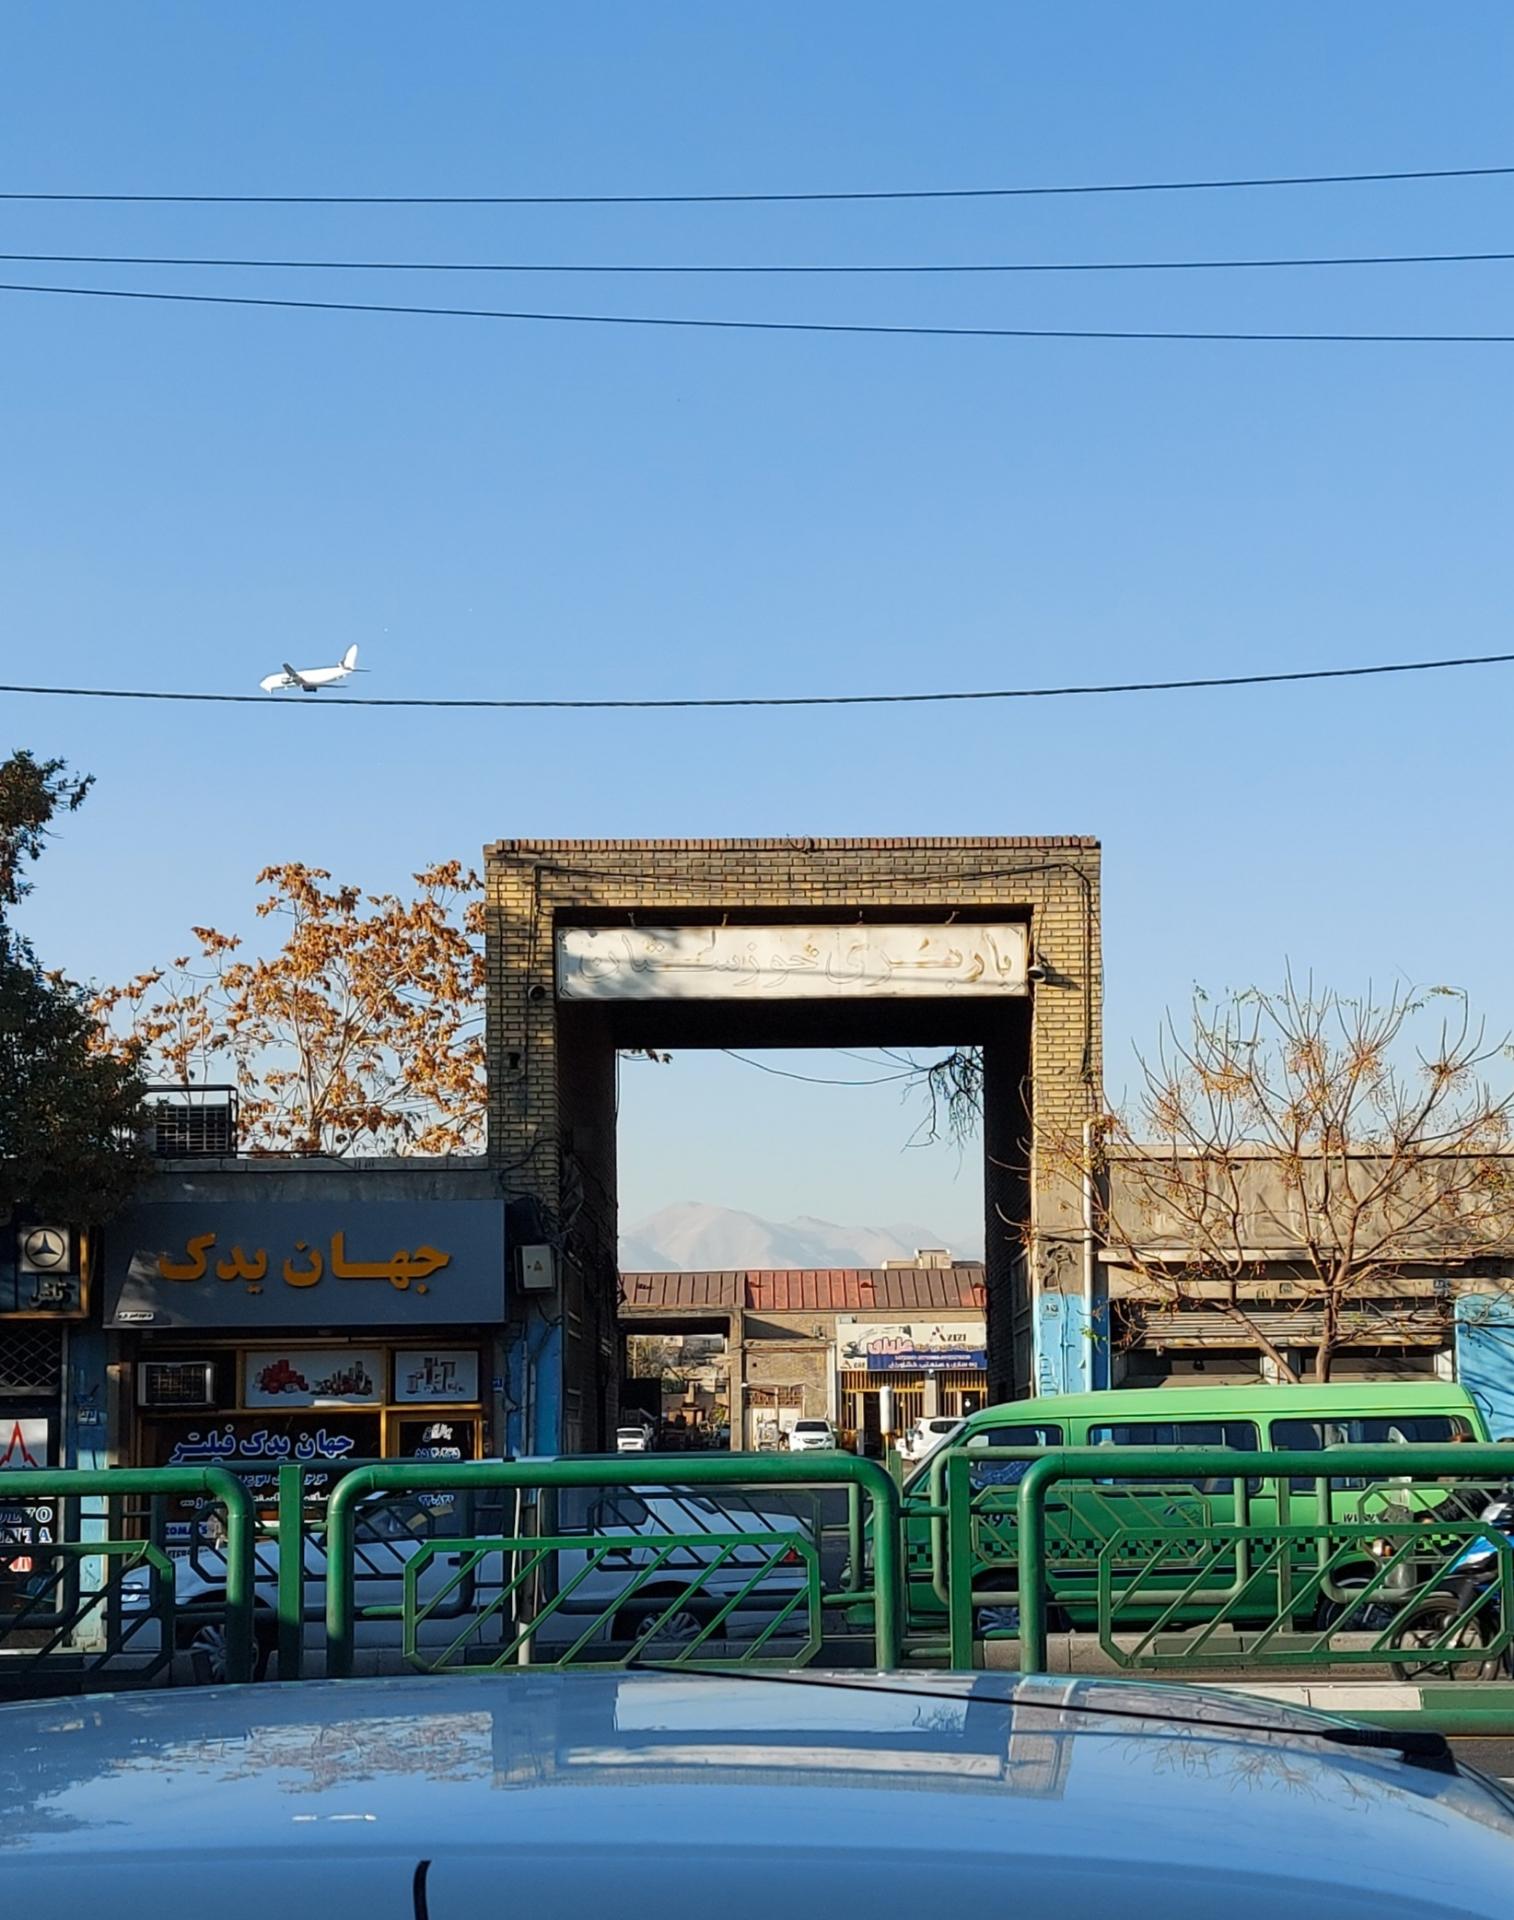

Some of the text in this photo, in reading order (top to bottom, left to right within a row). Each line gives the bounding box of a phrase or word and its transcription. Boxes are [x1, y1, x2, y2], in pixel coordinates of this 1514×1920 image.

[579, 932, 818, 988] خوزستان
[159, 1231, 452, 1295] جهان یدک
[168, 1424, 355, 1465] جهان یدک فیلتر
